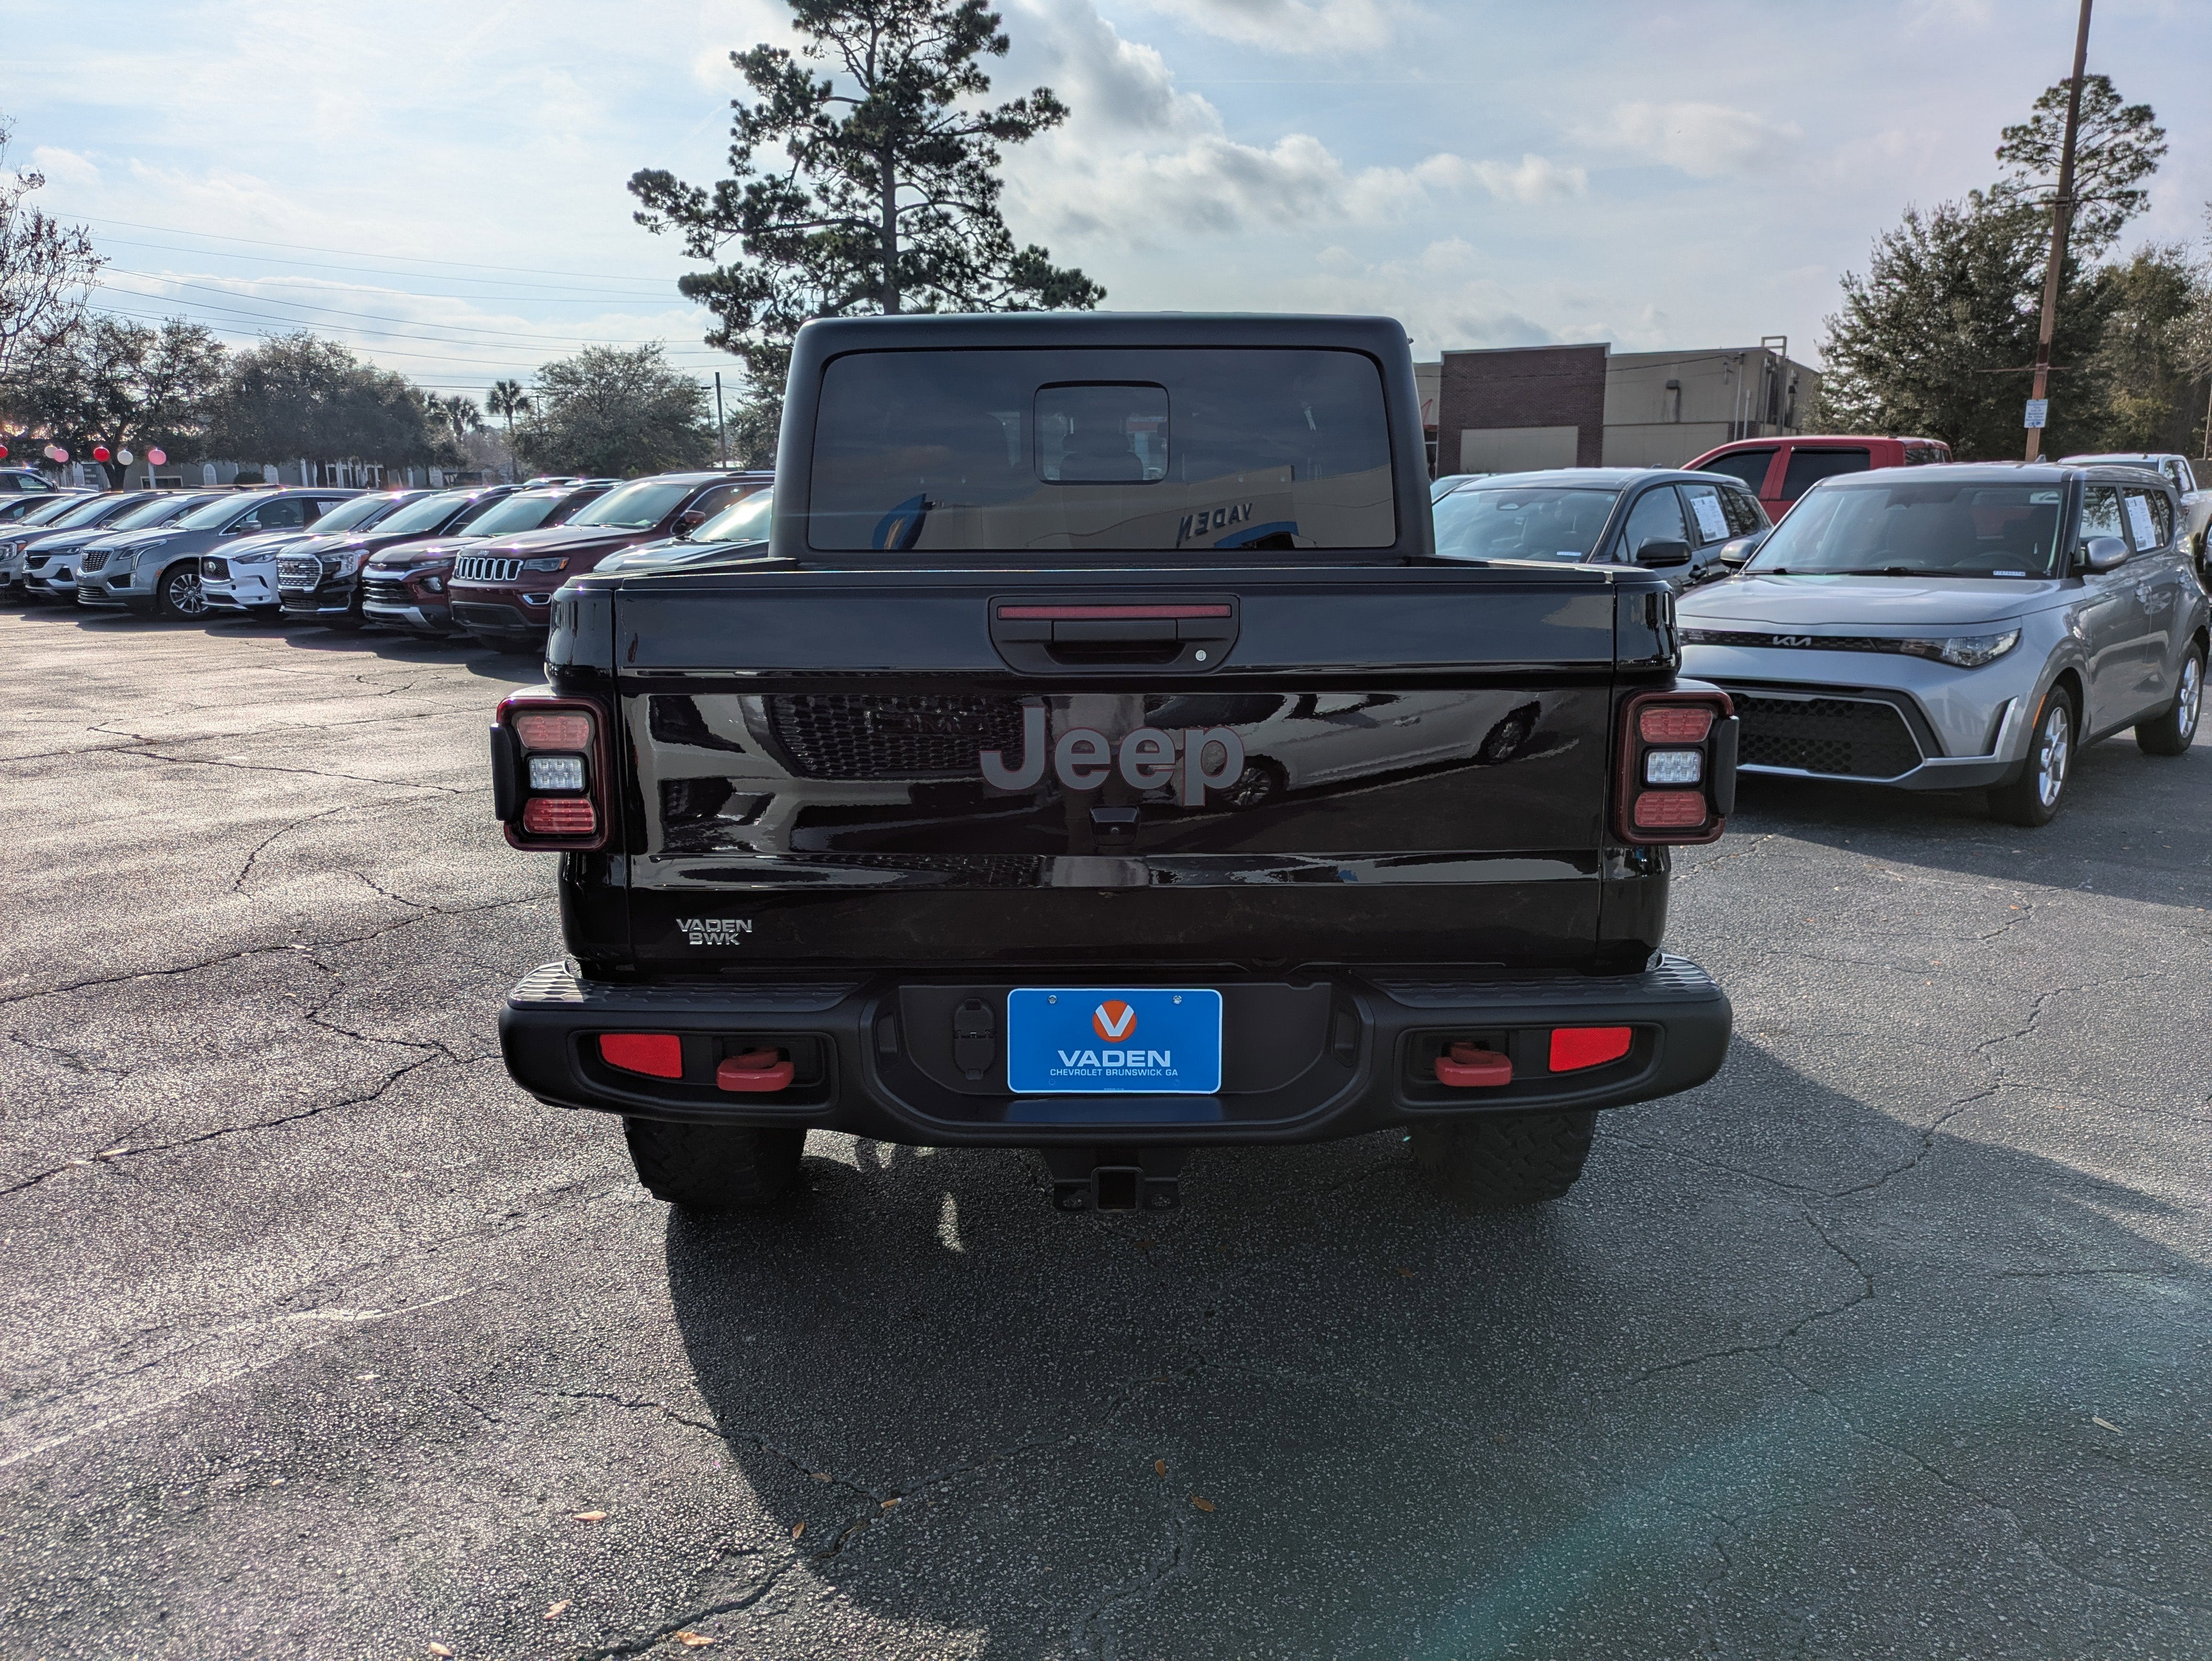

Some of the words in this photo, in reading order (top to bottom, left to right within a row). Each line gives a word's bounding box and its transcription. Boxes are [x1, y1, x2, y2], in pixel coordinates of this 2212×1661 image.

[979, 705, 1244, 807] Jeep
[676, 919, 752, 932] VADEN
[689, 933, 740, 945] BWK
[1095, 1004, 1134, 1037] V
[1058, 1050, 1171, 1067] VADEN
